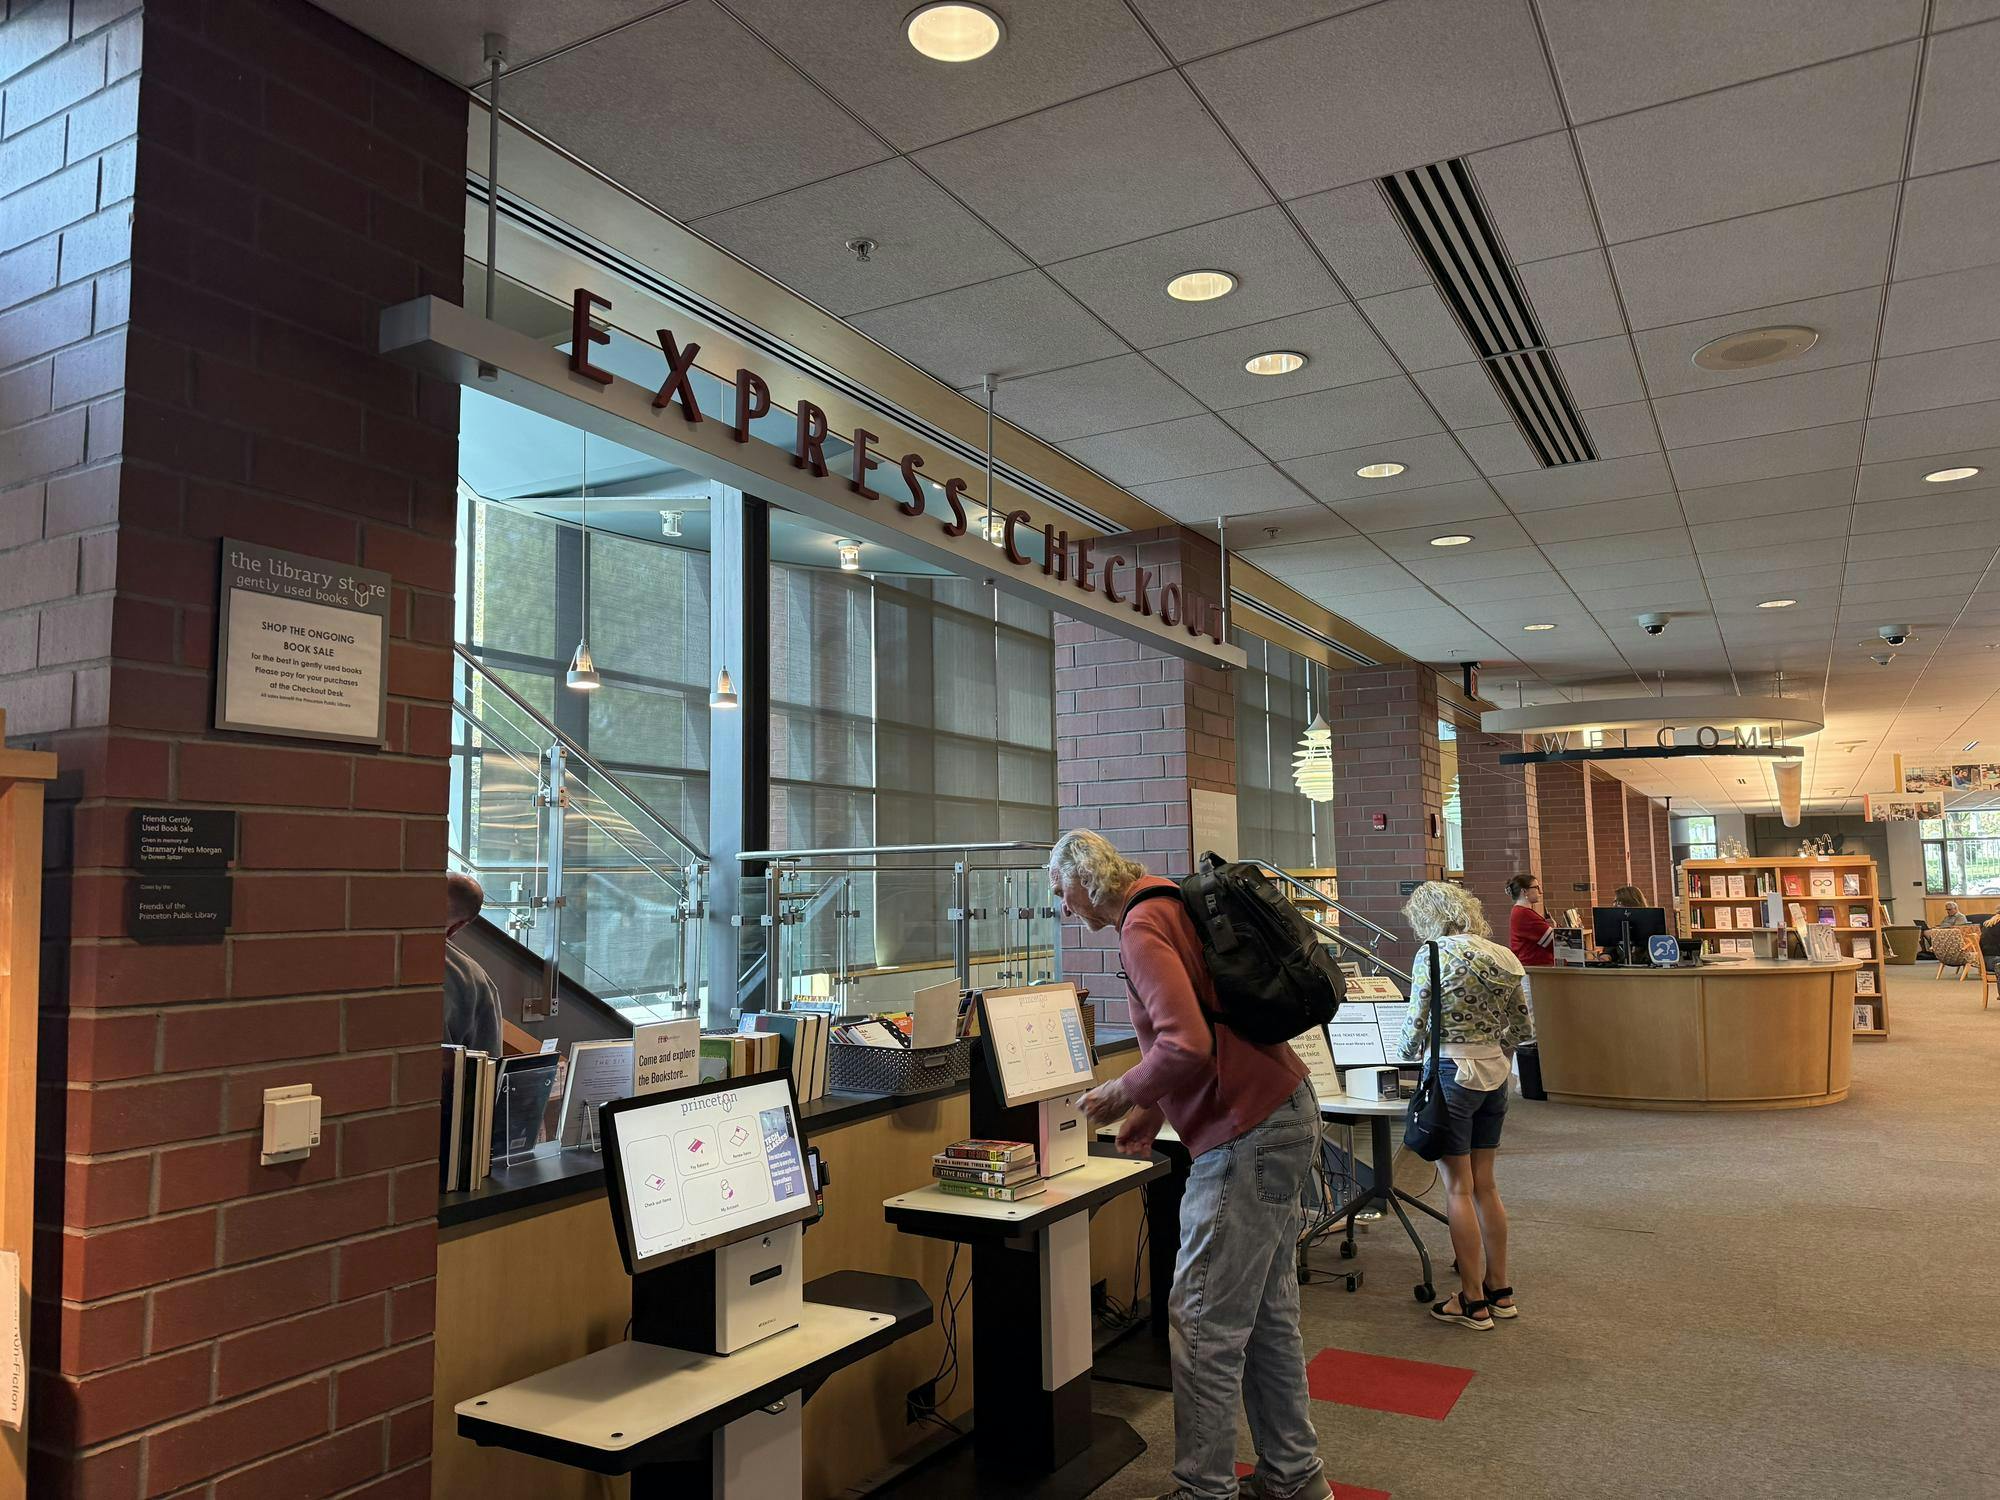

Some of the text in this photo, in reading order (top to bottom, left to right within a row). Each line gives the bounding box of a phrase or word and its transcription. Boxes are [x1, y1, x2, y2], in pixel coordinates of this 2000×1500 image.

[569, 288, 967, 537] EXPRESS
[230, 552, 385, 600] the library store
[1005, 510, 1223, 645] CHECKOUT
[237, 575, 349, 606] gently used books
[262, 621, 355, 644] SHOP THE ONGOING
[283, 642, 334, 657] BOOK SALE
[251, 652, 261, 661] for
[262, 654, 275, 664] the
[276, 656, 292, 665] best
[301, 660, 322, 672] gently
[323, 663, 341, 672] used
[341, 665, 362, 675] books
[254, 666, 359, 687] Please pay for your purchases
[278, 683, 291, 691] the
[292, 684, 326, 696] Checkout
[1541, 725, 1784, 755] WELCOME
[142, 815, 192, 824] Friends Gently
[141, 846, 176, 854] Claramary
[196, 846, 222, 855] Morgan
[195, 912, 217, 920] Library
[639, 1048, 695, 1066] Come and explore
[639, 1074, 649, 1086] the
[652, 1070, 688, 1084] Bookstore...
[680, 1092, 738, 1116] princeton
[765, 1131, 779, 1146] TECH
